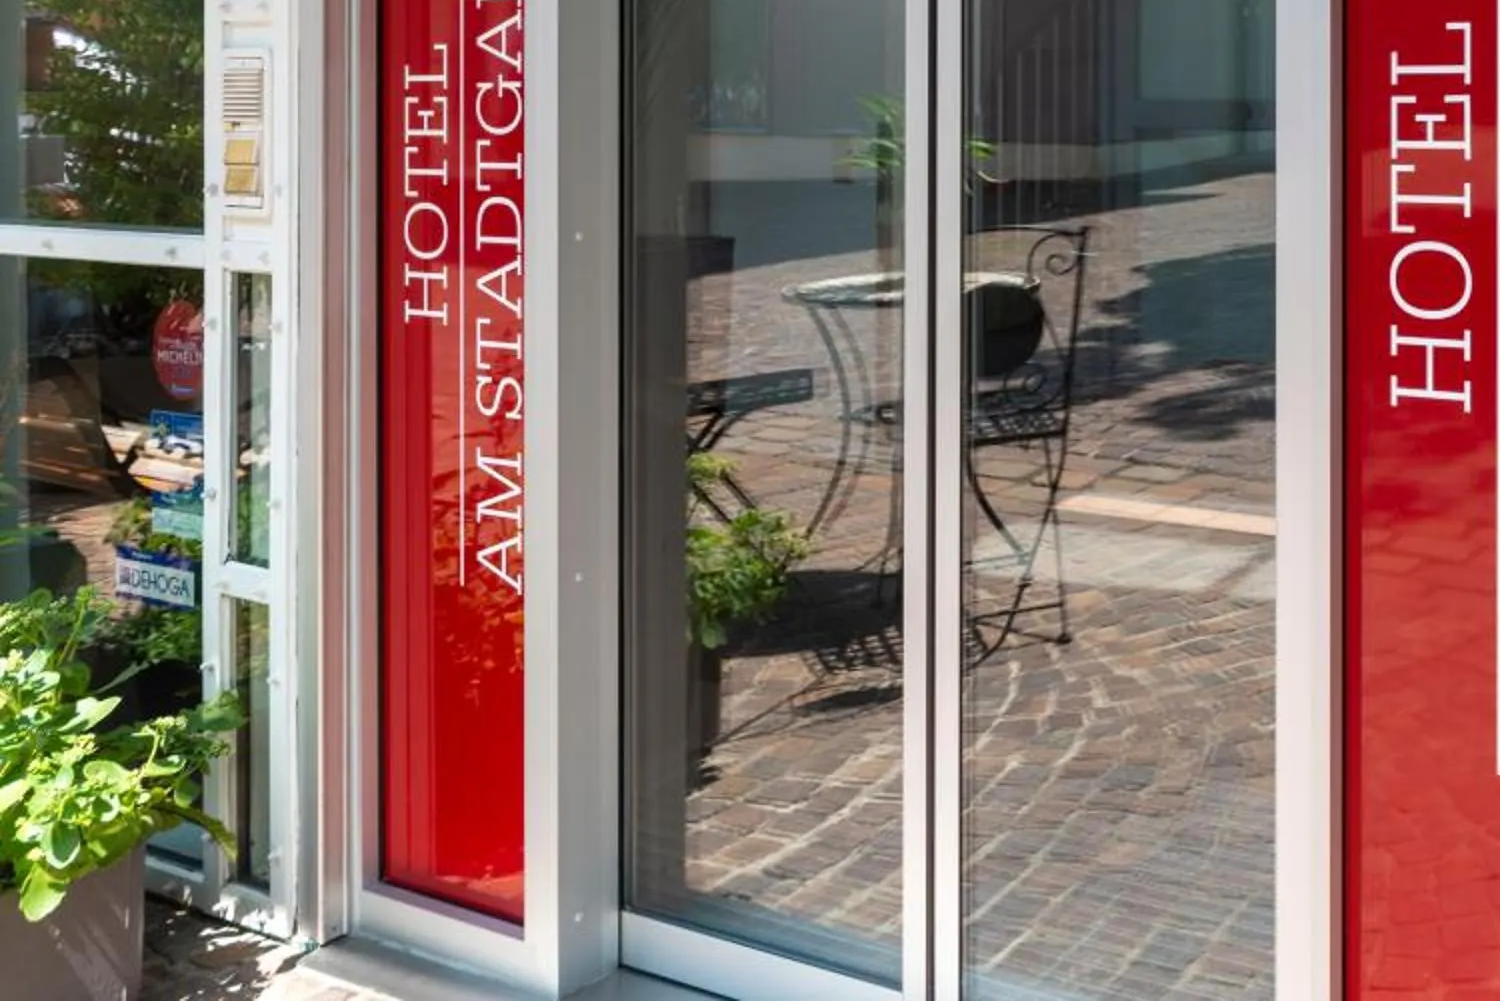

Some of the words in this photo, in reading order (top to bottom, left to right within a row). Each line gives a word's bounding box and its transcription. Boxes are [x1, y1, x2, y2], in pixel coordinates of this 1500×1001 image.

[403, 42, 448, 327] HOTEL
[1389, 21, 1472, 413] HOTEL
[475, 446, 523, 597] AM
